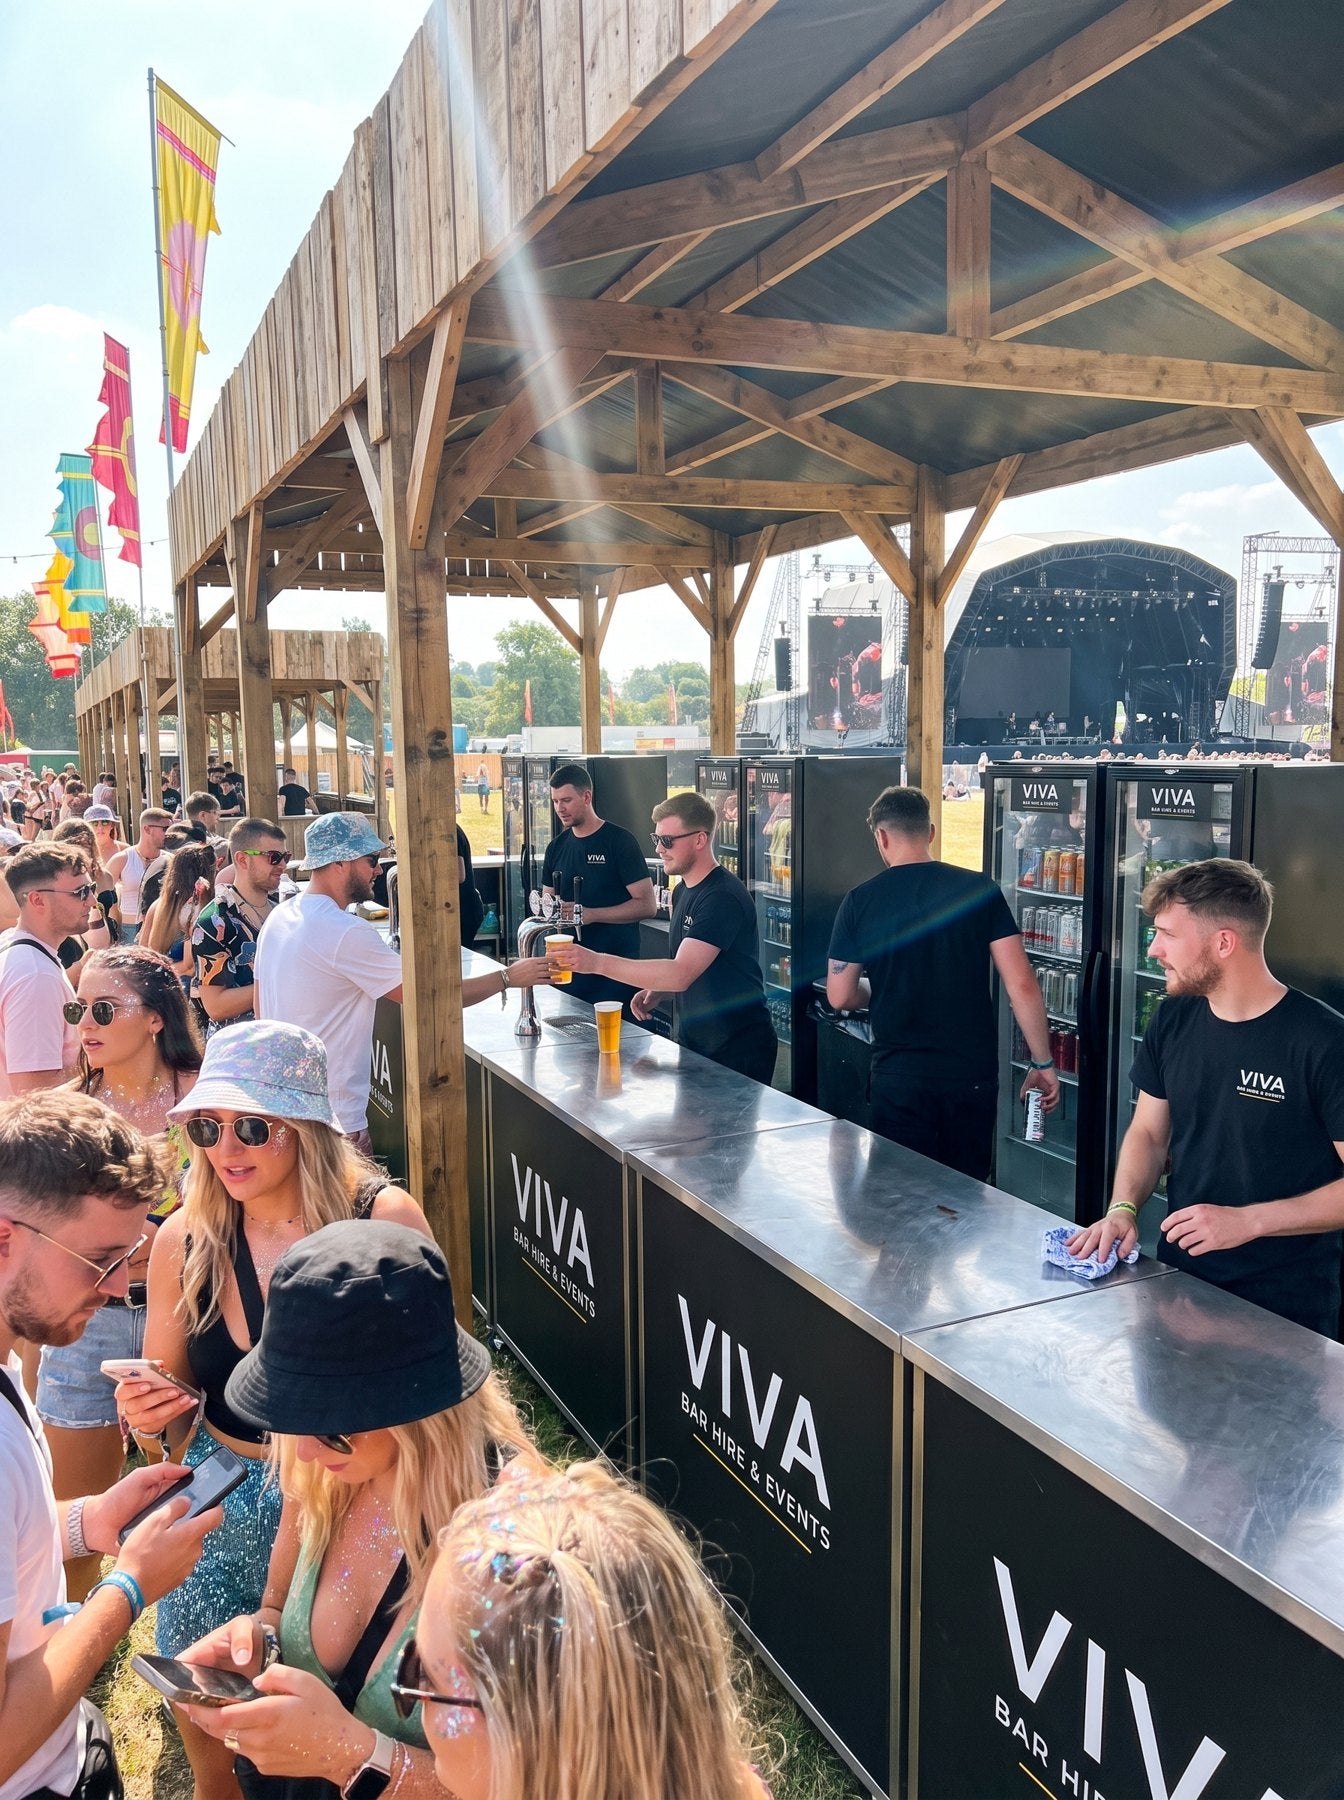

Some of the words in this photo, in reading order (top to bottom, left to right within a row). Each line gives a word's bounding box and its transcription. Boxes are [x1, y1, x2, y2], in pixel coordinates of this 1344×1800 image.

[711, 771, 727, 781] VIVA
[761, 773, 779, 784] VIVA
[1022, 784, 1058, 800] VIVA
[1151, 788, 1195, 806] VIVA
[587, 854, 606, 862] VIVA
[371, 1040, 393, 1094] VA
[1240, 1069, 1285, 1093] VIVA
[510, 1152, 595, 1289] VIVA
[514, 1226, 529, 1252] BAR
[532, 1244, 550, 1274] HIRE
[552, 1265, 558, 1282] &
[560, 1272, 596, 1318] EVENTS
[677, 1293, 832, 1512] VIVA
[681, 1391, 708, 1433] BAR
[712, 1421, 746, 1471] HIRE
[750, 1460, 760, 1484] &
[766, 1473, 831, 1550] EVENTS
[993, 1556, 1285, 1800] VIV
[995, 1695, 1048, 1767] BAR
[1061, 1758, 1107, 1800] HI
